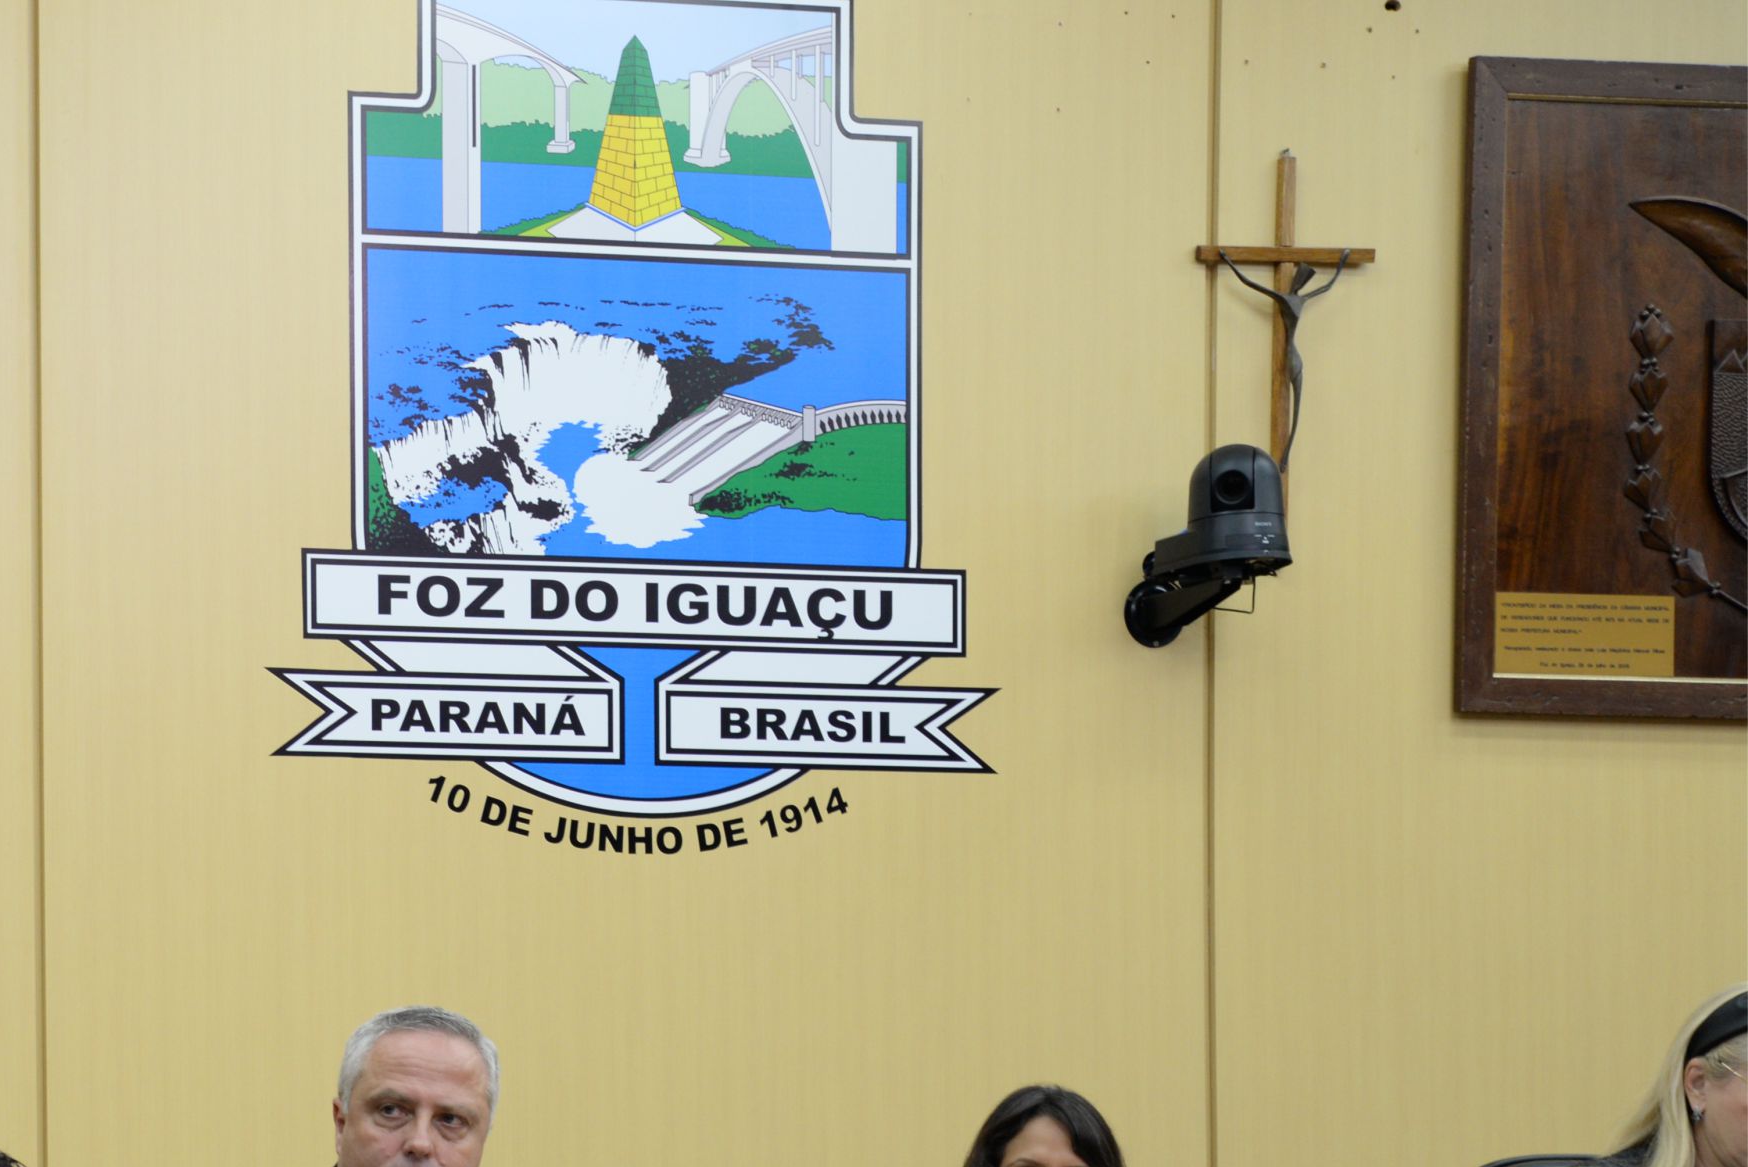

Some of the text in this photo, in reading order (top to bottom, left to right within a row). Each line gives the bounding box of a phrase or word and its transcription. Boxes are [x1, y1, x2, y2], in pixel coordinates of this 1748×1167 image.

[378, 574, 893, 639] FOZ DO IGUAÇU
[371, 695, 586, 736] PARANÁ
[720, 706, 906, 744] BRASIL
[427, 775, 848, 855] 10 DE JUNHO DE 1914
